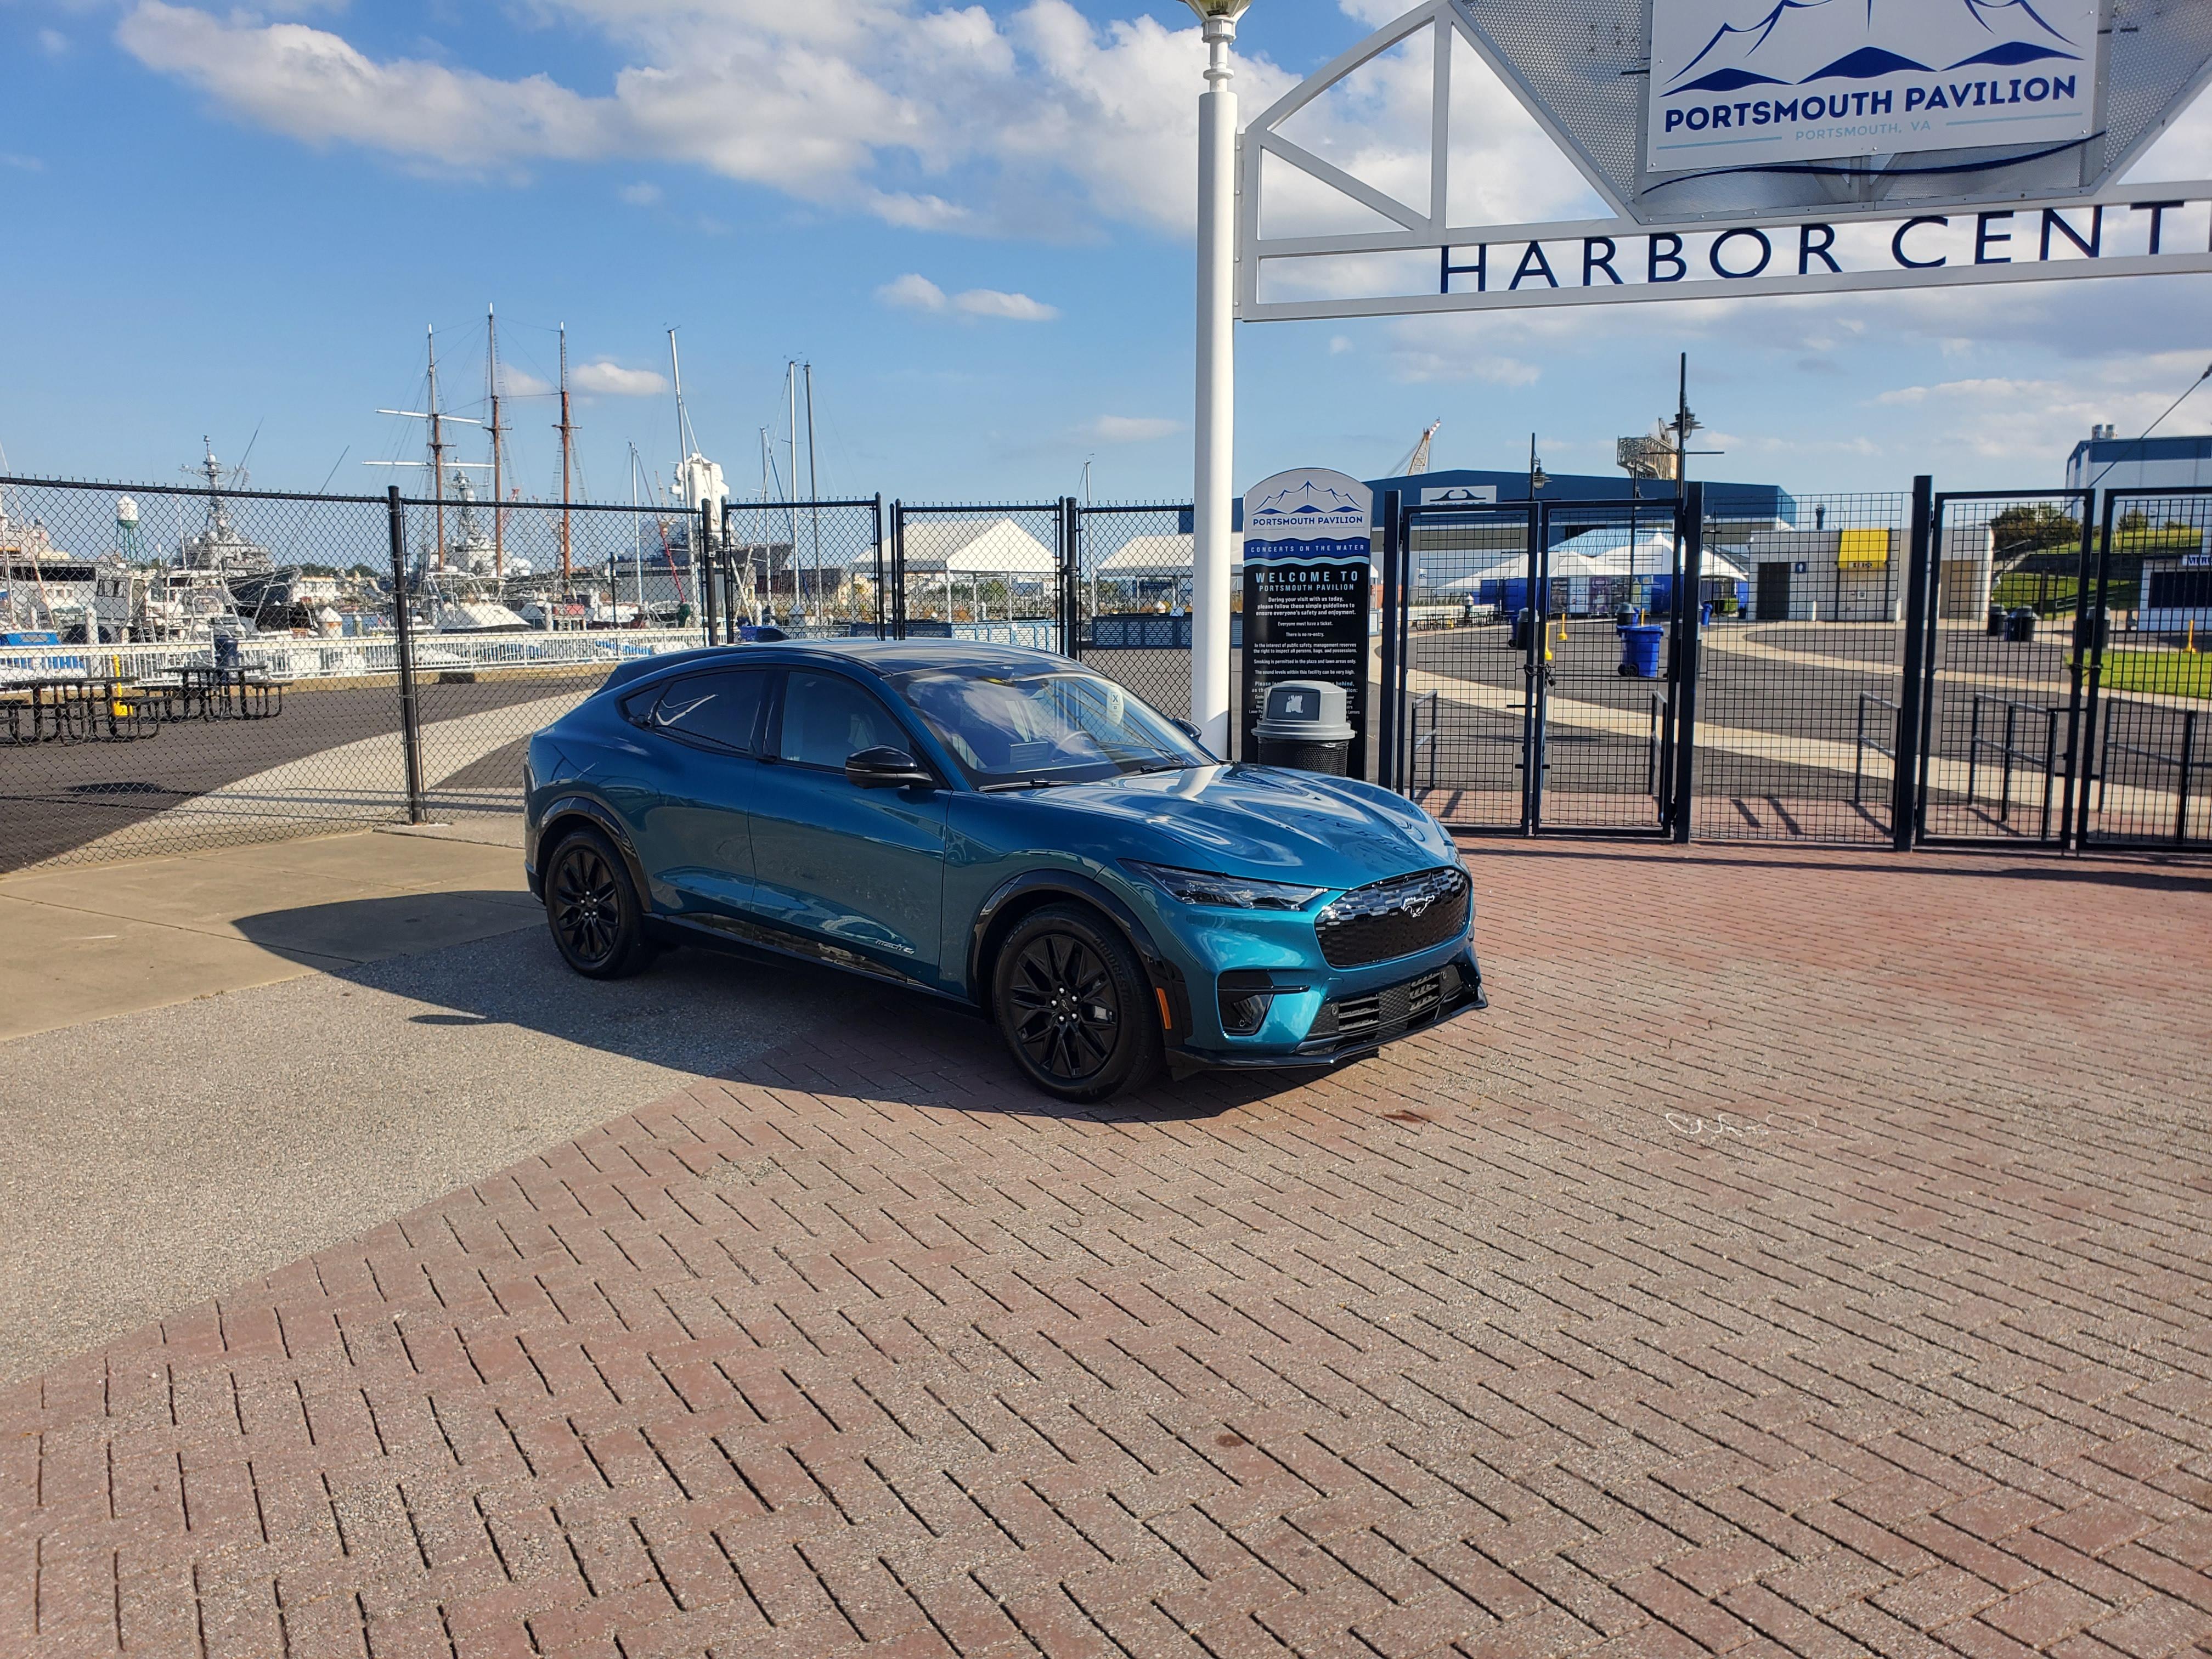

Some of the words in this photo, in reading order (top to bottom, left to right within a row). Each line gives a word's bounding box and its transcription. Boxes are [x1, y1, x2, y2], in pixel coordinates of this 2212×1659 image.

[1664, 89, 1893, 133] PORTSMOUTH
[1905, 75, 2076, 112] PAVILION
[1795, 123, 1902, 142] PORTSMOUTH,
[1910, 120, 1931, 132] VA
[1440, 223, 1843, 294] HARBOR
[1891, 200, 2212, 269] CENT
[1253, 517, 1315, 526] PORTSMOUTH
[1318, 516, 1363, 524] PAVILION
[1255, 571, 1330, 584] WELCOME
[1340, 571, 1358, 582] TO
